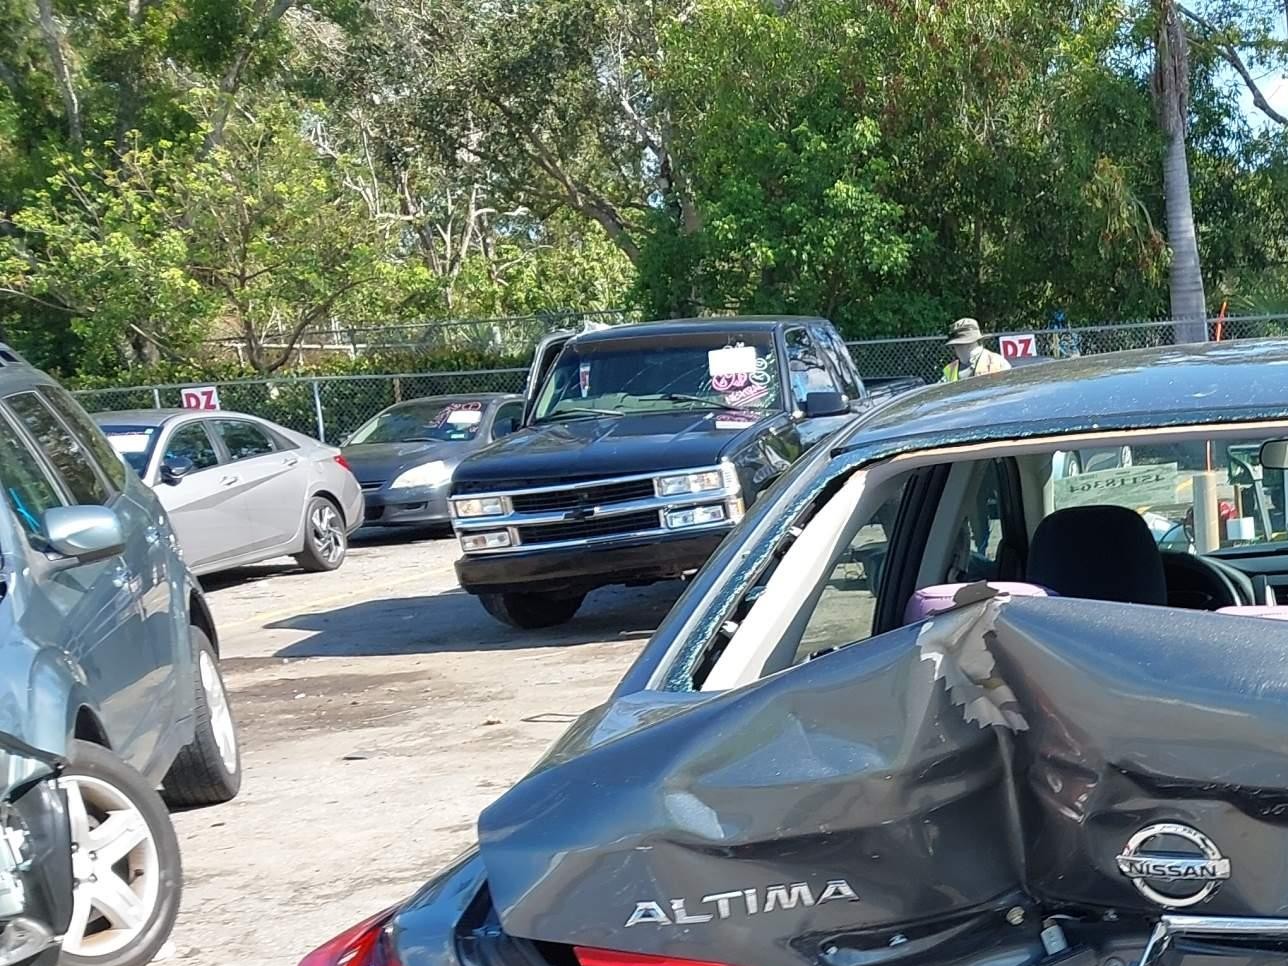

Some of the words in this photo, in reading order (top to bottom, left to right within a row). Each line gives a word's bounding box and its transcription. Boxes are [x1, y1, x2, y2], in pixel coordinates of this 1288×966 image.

[1002, 338, 1032, 360] DZ
[184, 390, 216, 409] DZ
[1129, 863, 1216, 877] NISSAN
[624, 880, 859, 926] ALTIMA
